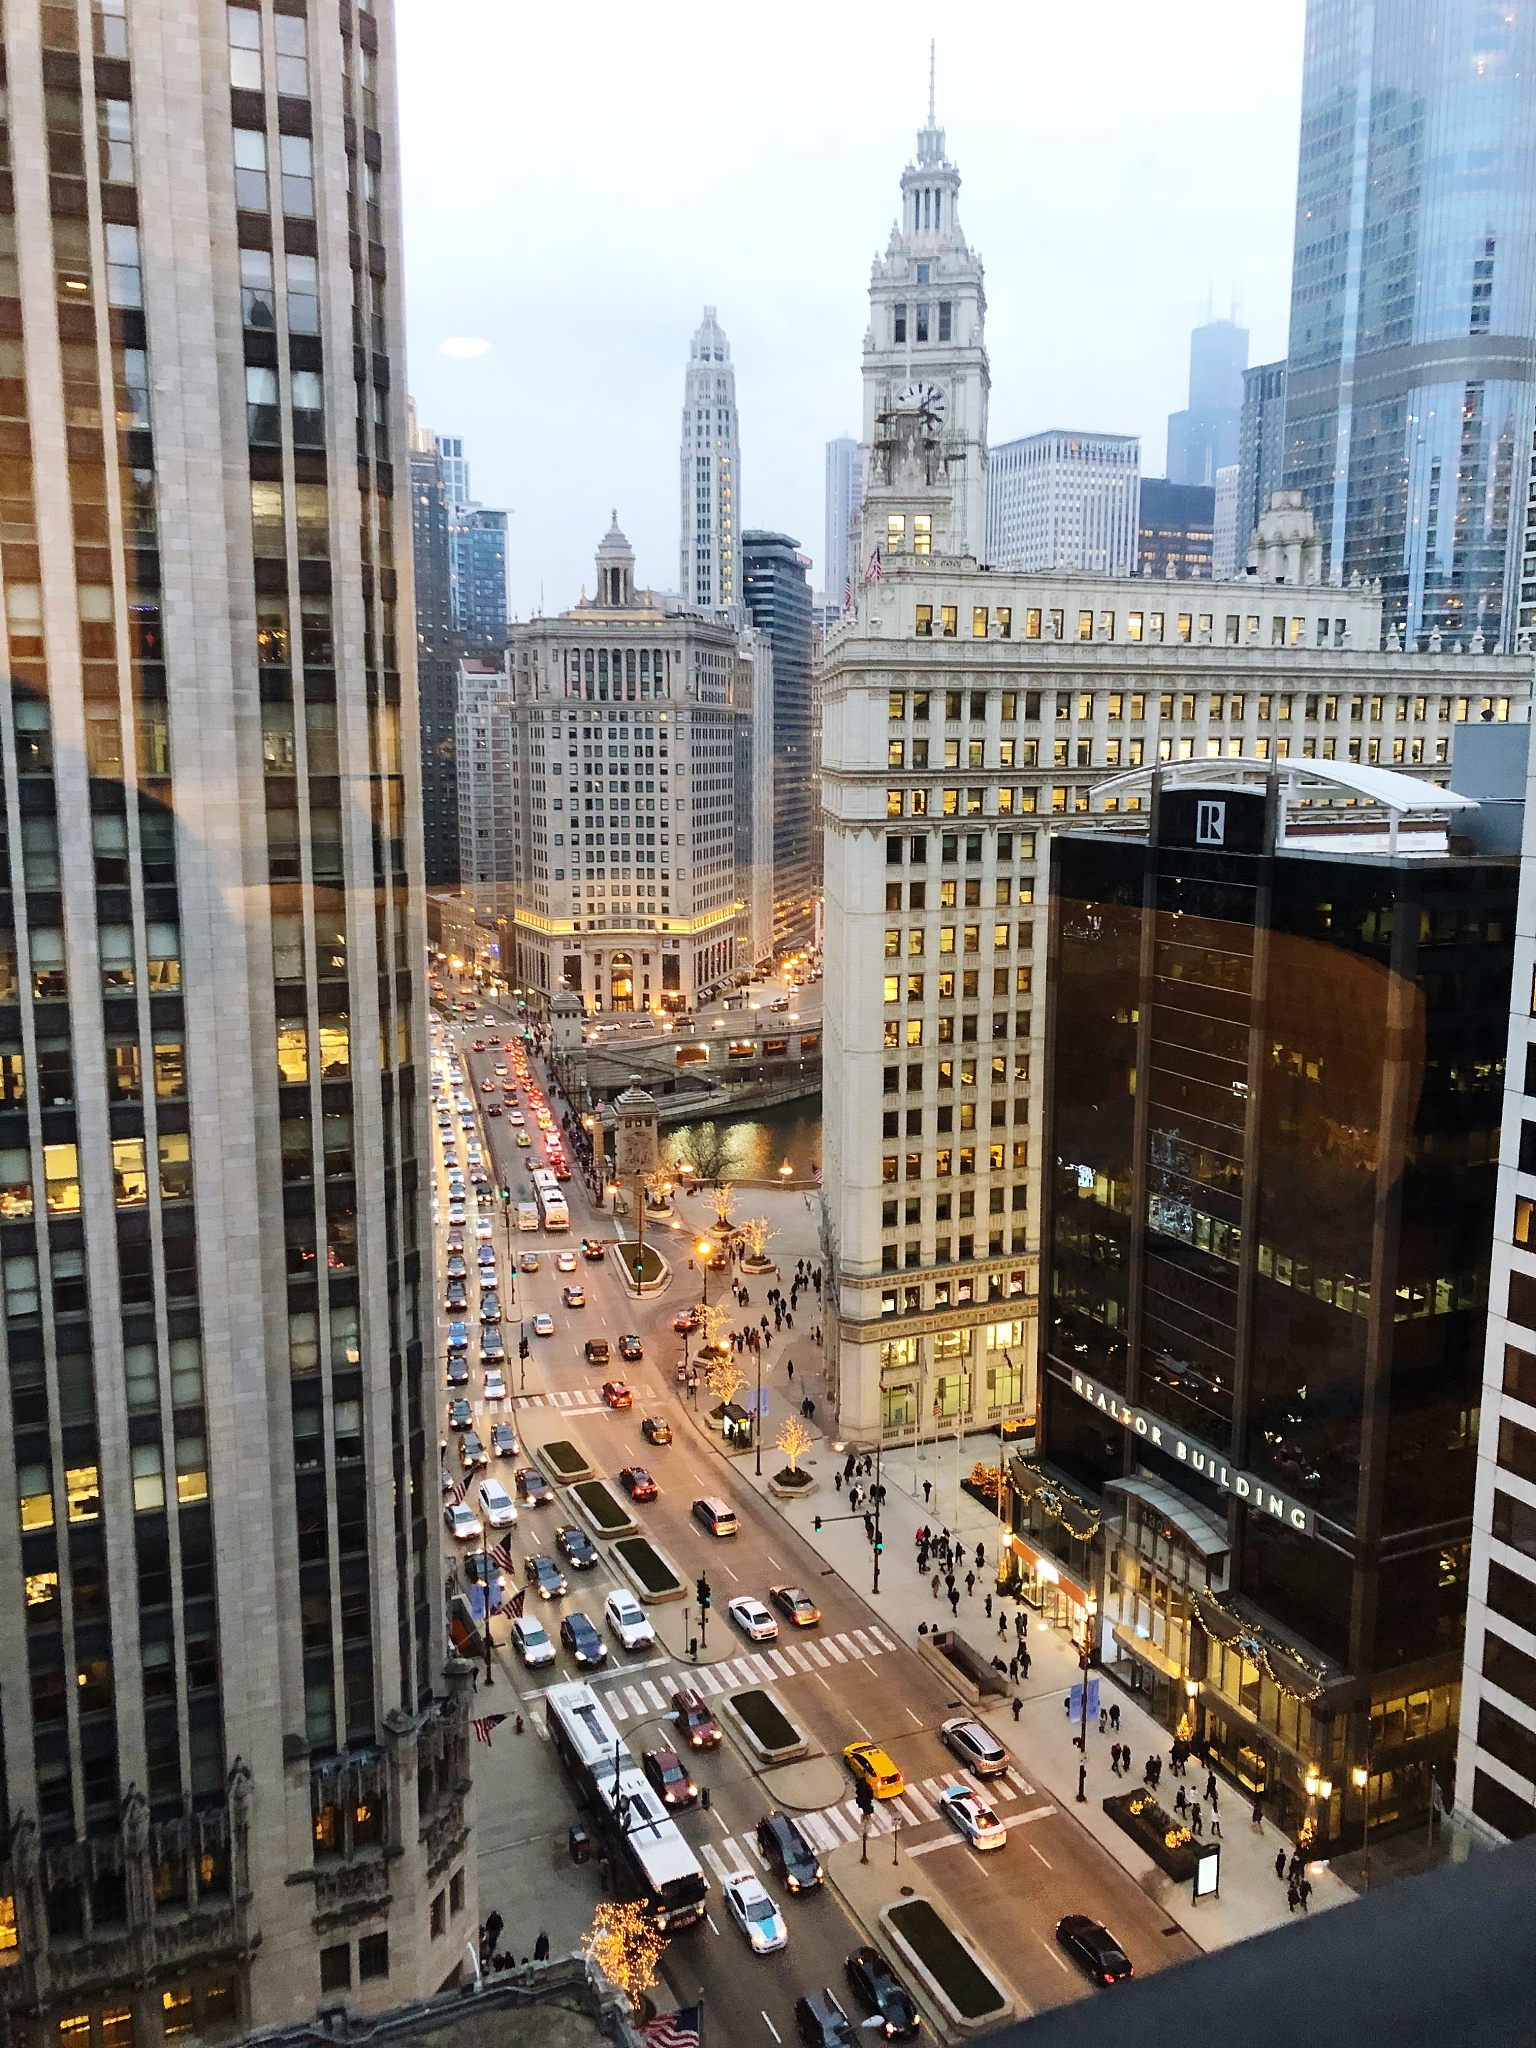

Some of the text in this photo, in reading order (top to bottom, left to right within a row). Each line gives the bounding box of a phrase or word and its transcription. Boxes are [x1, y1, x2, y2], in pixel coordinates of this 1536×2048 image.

[1082, 440, 1127, 454] KEMPER
[1200, 804, 1222, 841] R
[1075, 1375, 1307, 1530] REALTOR BUILDING
[1142, 1510, 1163, 1533] 430
